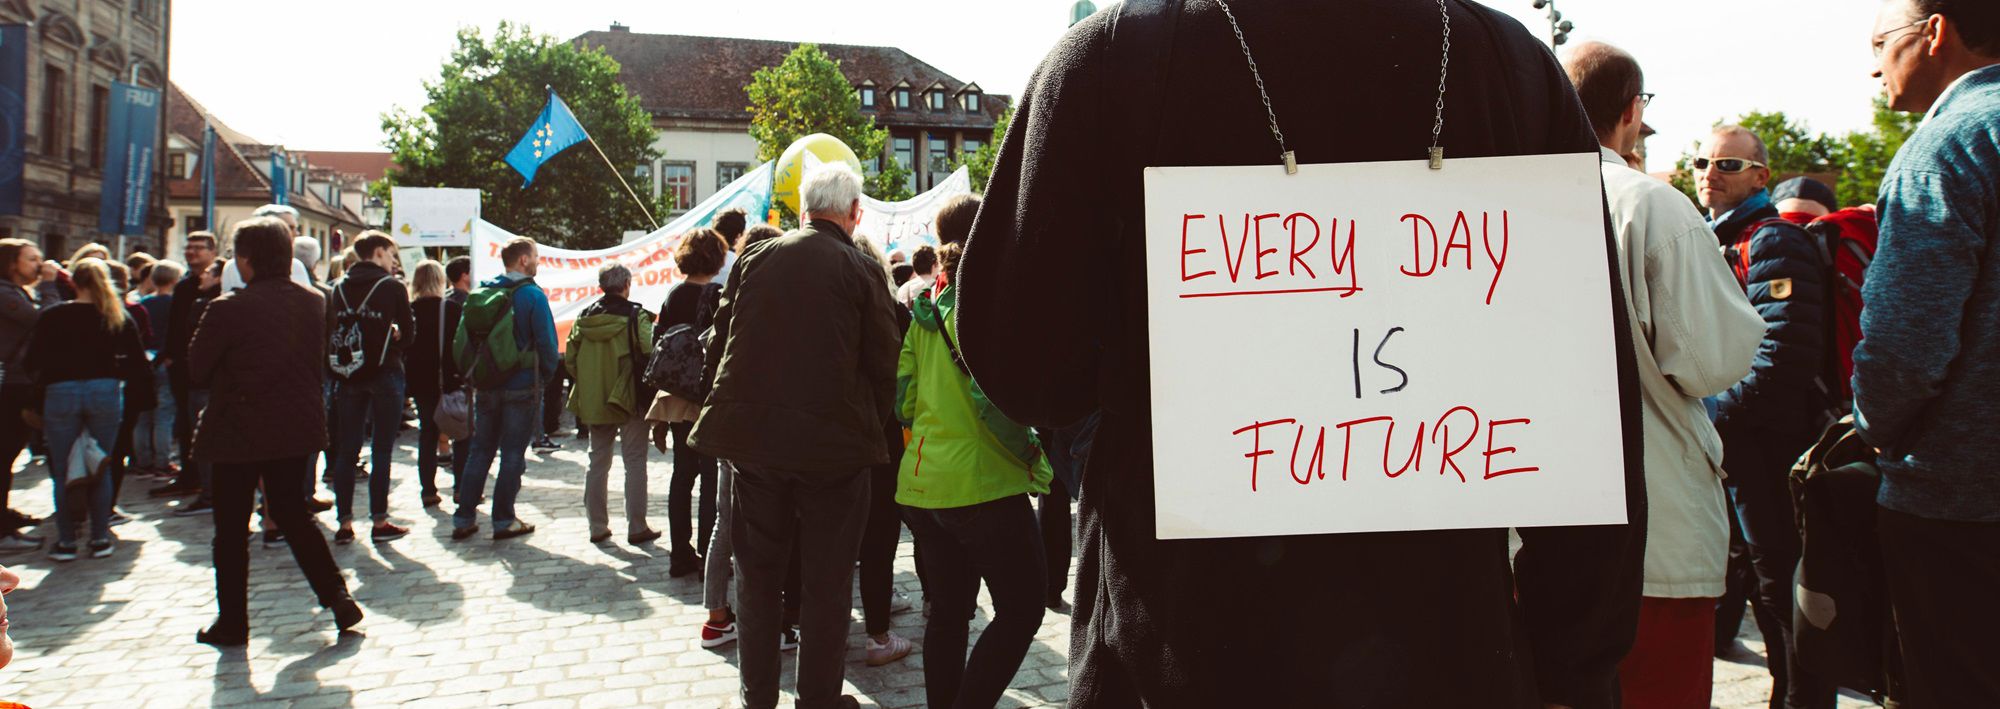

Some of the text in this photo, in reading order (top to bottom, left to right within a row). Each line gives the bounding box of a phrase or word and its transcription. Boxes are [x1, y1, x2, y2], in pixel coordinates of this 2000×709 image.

[1181, 210, 1508, 304] EVERY DAY
[1353, 327, 1408, 398] IS
[1232, 406, 1539, 492] FUTURE
